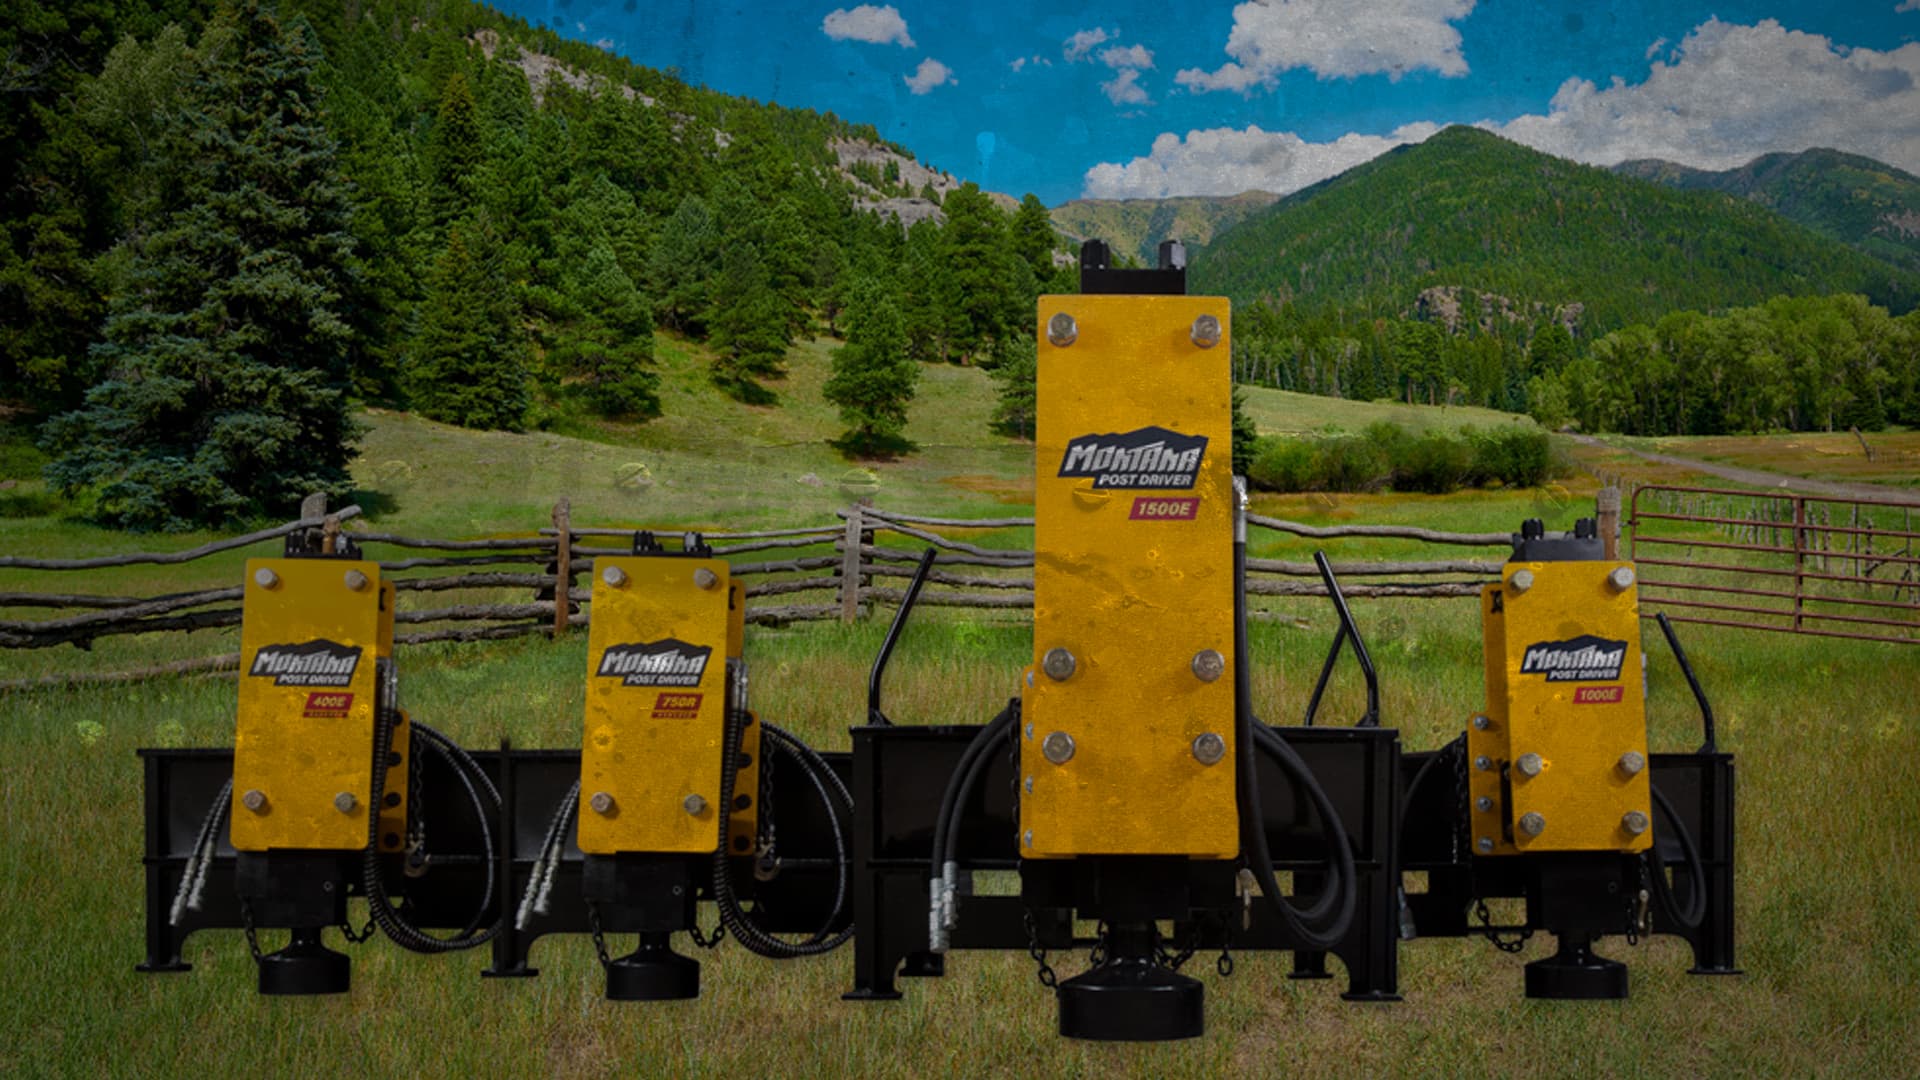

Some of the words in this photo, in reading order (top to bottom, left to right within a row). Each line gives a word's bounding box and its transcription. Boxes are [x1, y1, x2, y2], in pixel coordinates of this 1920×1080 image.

[1064, 441, 1202, 472] MONTANA
[1099, 474, 1138, 486] POST
[1138, 474, 1192, 486] DRIVER
[1138, 502, 1192, 516] 1500E
[253, 650, 358, 674] MONTANA
[600, 649, 707, 674] MONTANA
[1523, 645, 1624, 670] MONTANA
[278, 674, 308, 684] POST
[308, 675, 350, 685] DRIVER
[626, 674, 657, 684] POST
[657, 675, 700, 685] DRIVER
[1548, 670, 1579, 680] POST
[1579, 669, 1618, 679] DRIVER
[1580, 689, 1618, 701] 1000E
[313, 696, 347, 707] 400E
